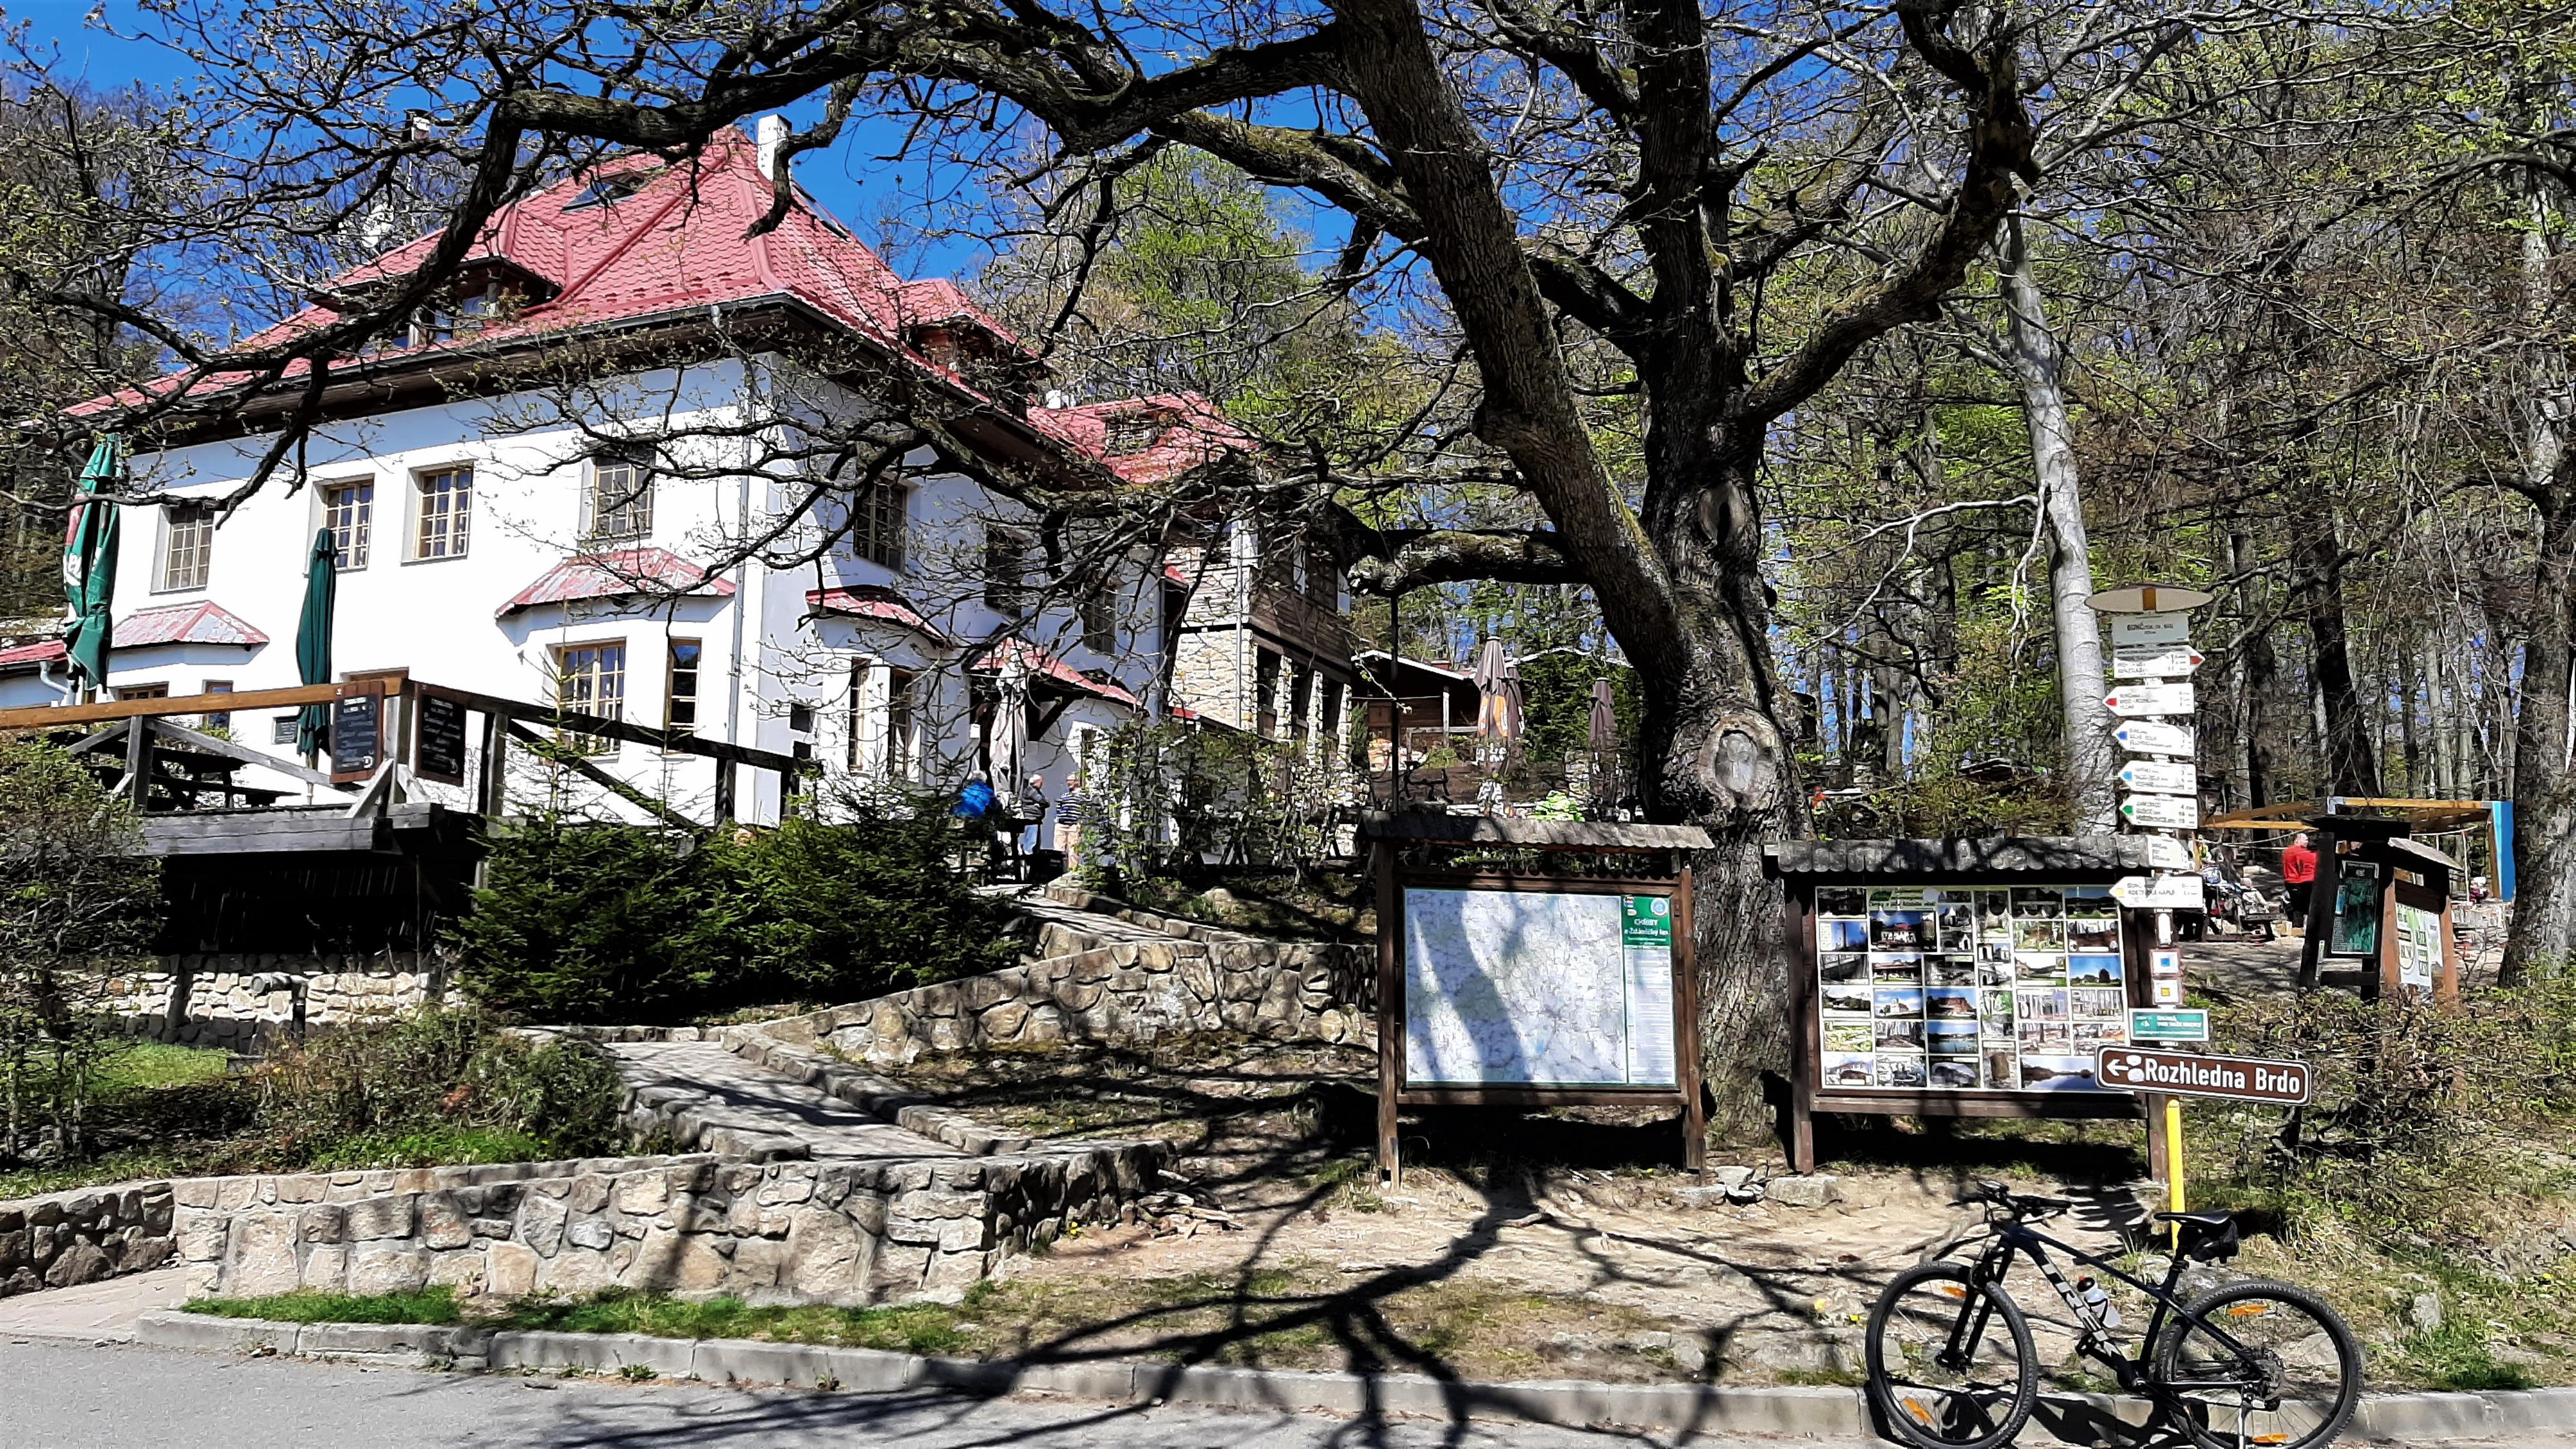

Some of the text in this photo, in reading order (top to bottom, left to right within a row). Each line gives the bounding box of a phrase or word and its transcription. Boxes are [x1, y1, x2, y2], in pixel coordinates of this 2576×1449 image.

[2145, 1058, 2300, 1094] Rozhledna Brdo
[2041, 1254, 2123, 1358] TREK
